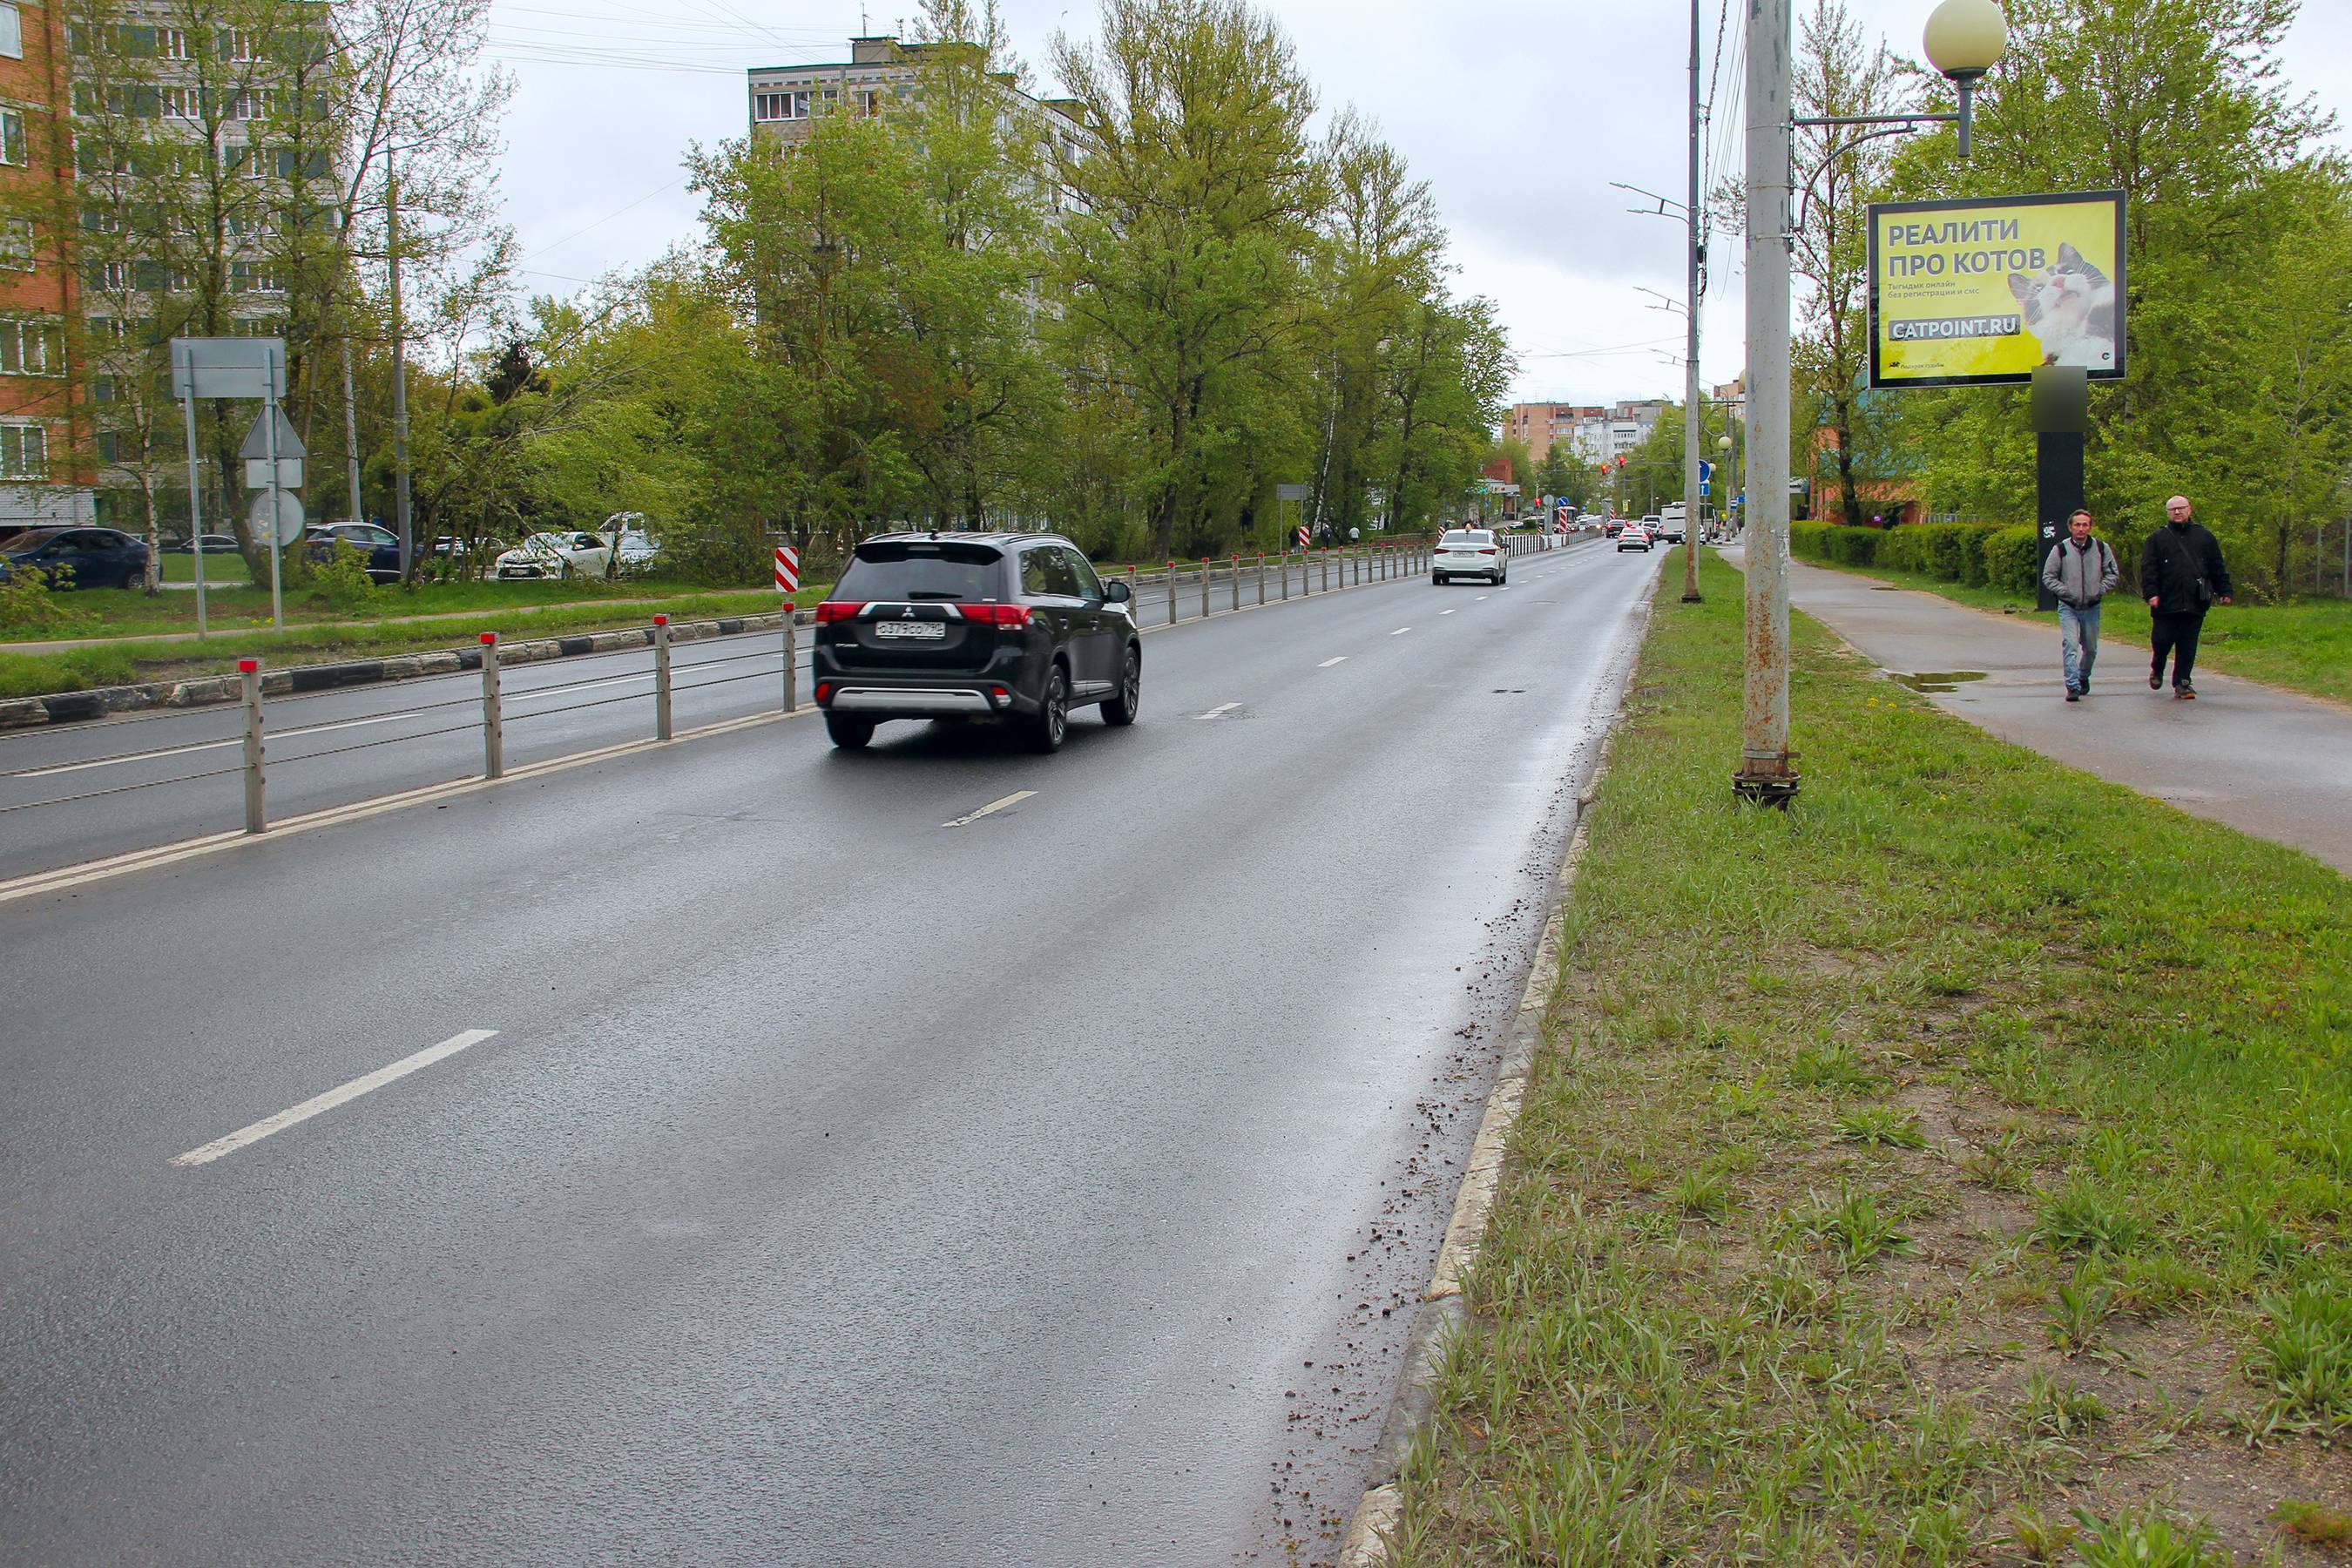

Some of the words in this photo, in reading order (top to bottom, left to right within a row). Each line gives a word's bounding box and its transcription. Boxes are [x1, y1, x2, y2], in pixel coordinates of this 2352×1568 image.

[1889, 219, 2018, 247] РЕАЛИТИ
[1889, 253, 1945, 277] ПРО
[1953, 248, 2046, 274] КОТОВ
[1903, 289, 1955, 299] регистрации
[1892, 317, 2017, 338] CATPOINT.RU
